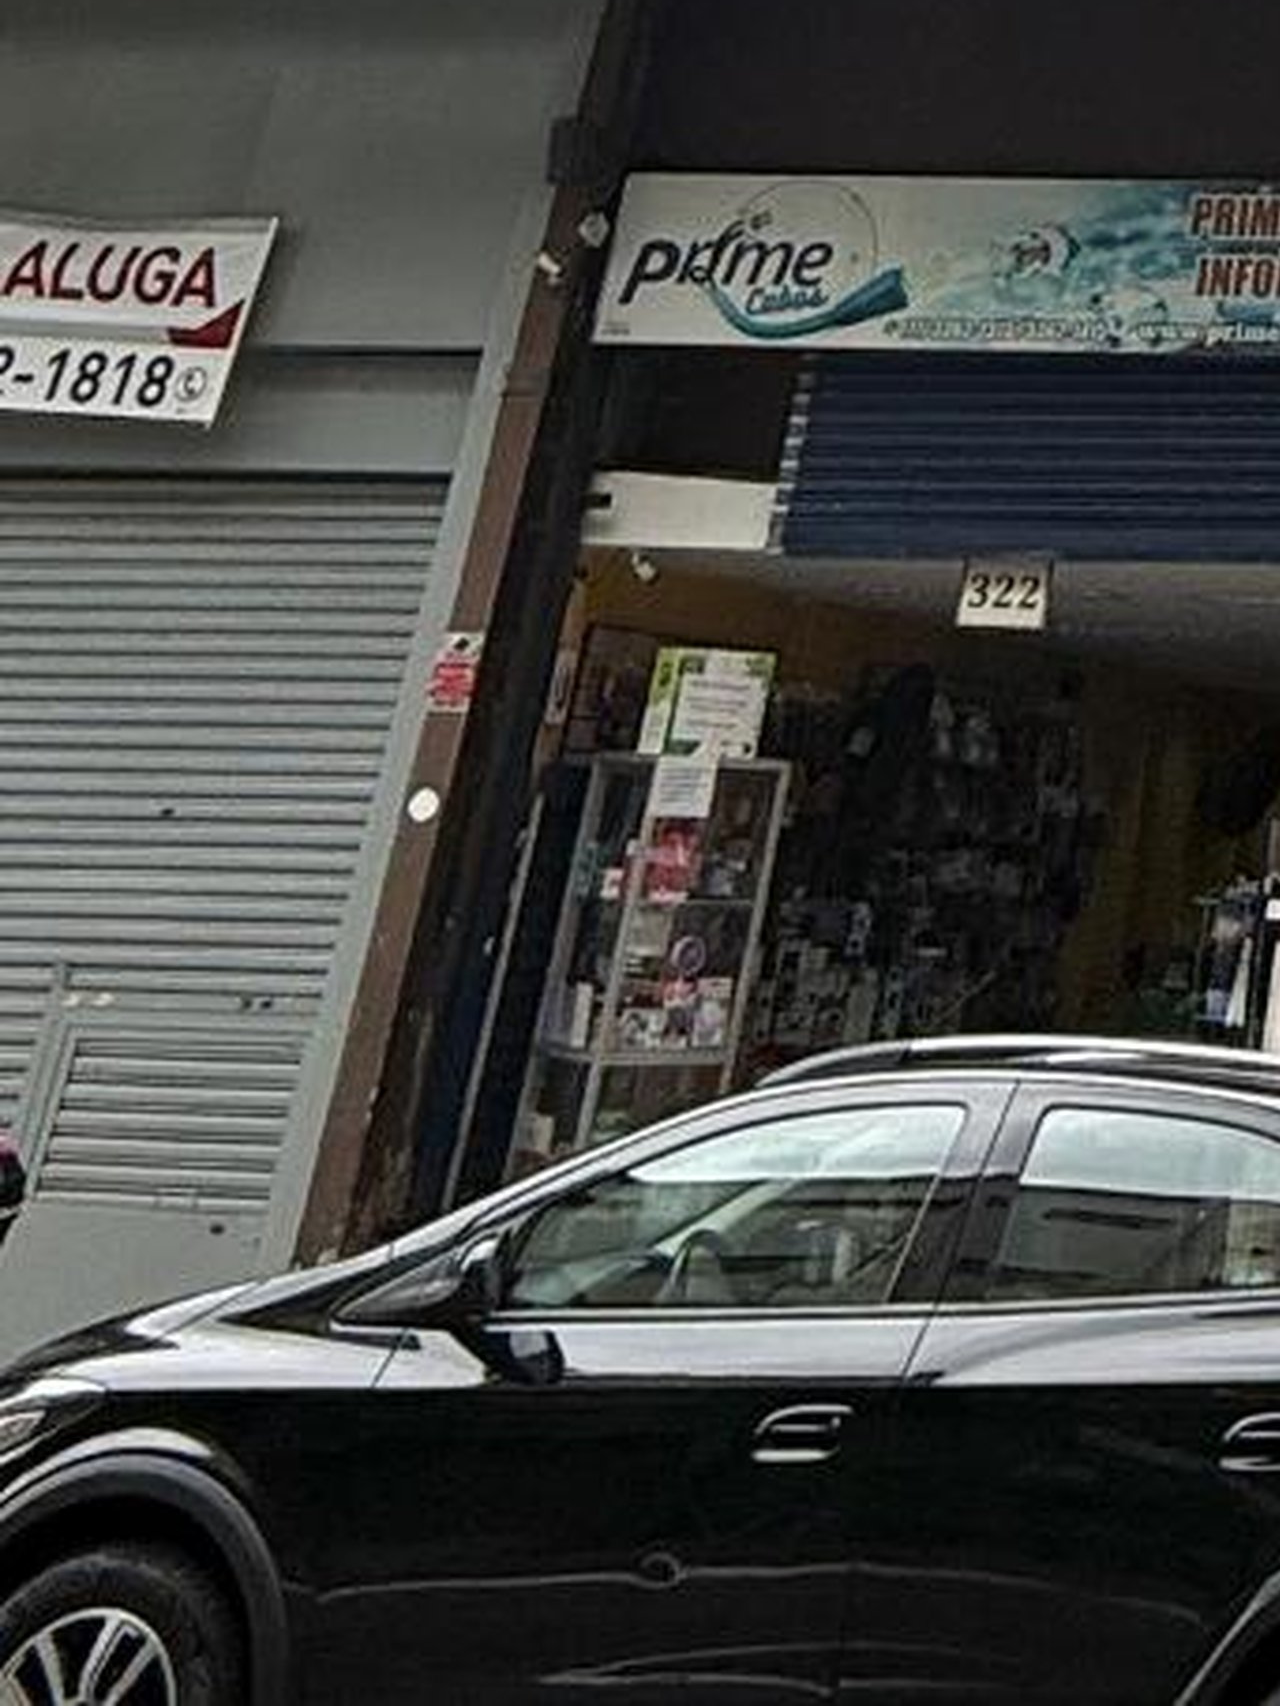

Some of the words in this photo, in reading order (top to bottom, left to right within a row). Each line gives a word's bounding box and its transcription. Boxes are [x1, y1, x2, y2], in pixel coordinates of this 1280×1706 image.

[1, 239, 217, 308] ALUGA
[617, 219, 833, 304] prime
[967, 572, 1041, 610] 322
